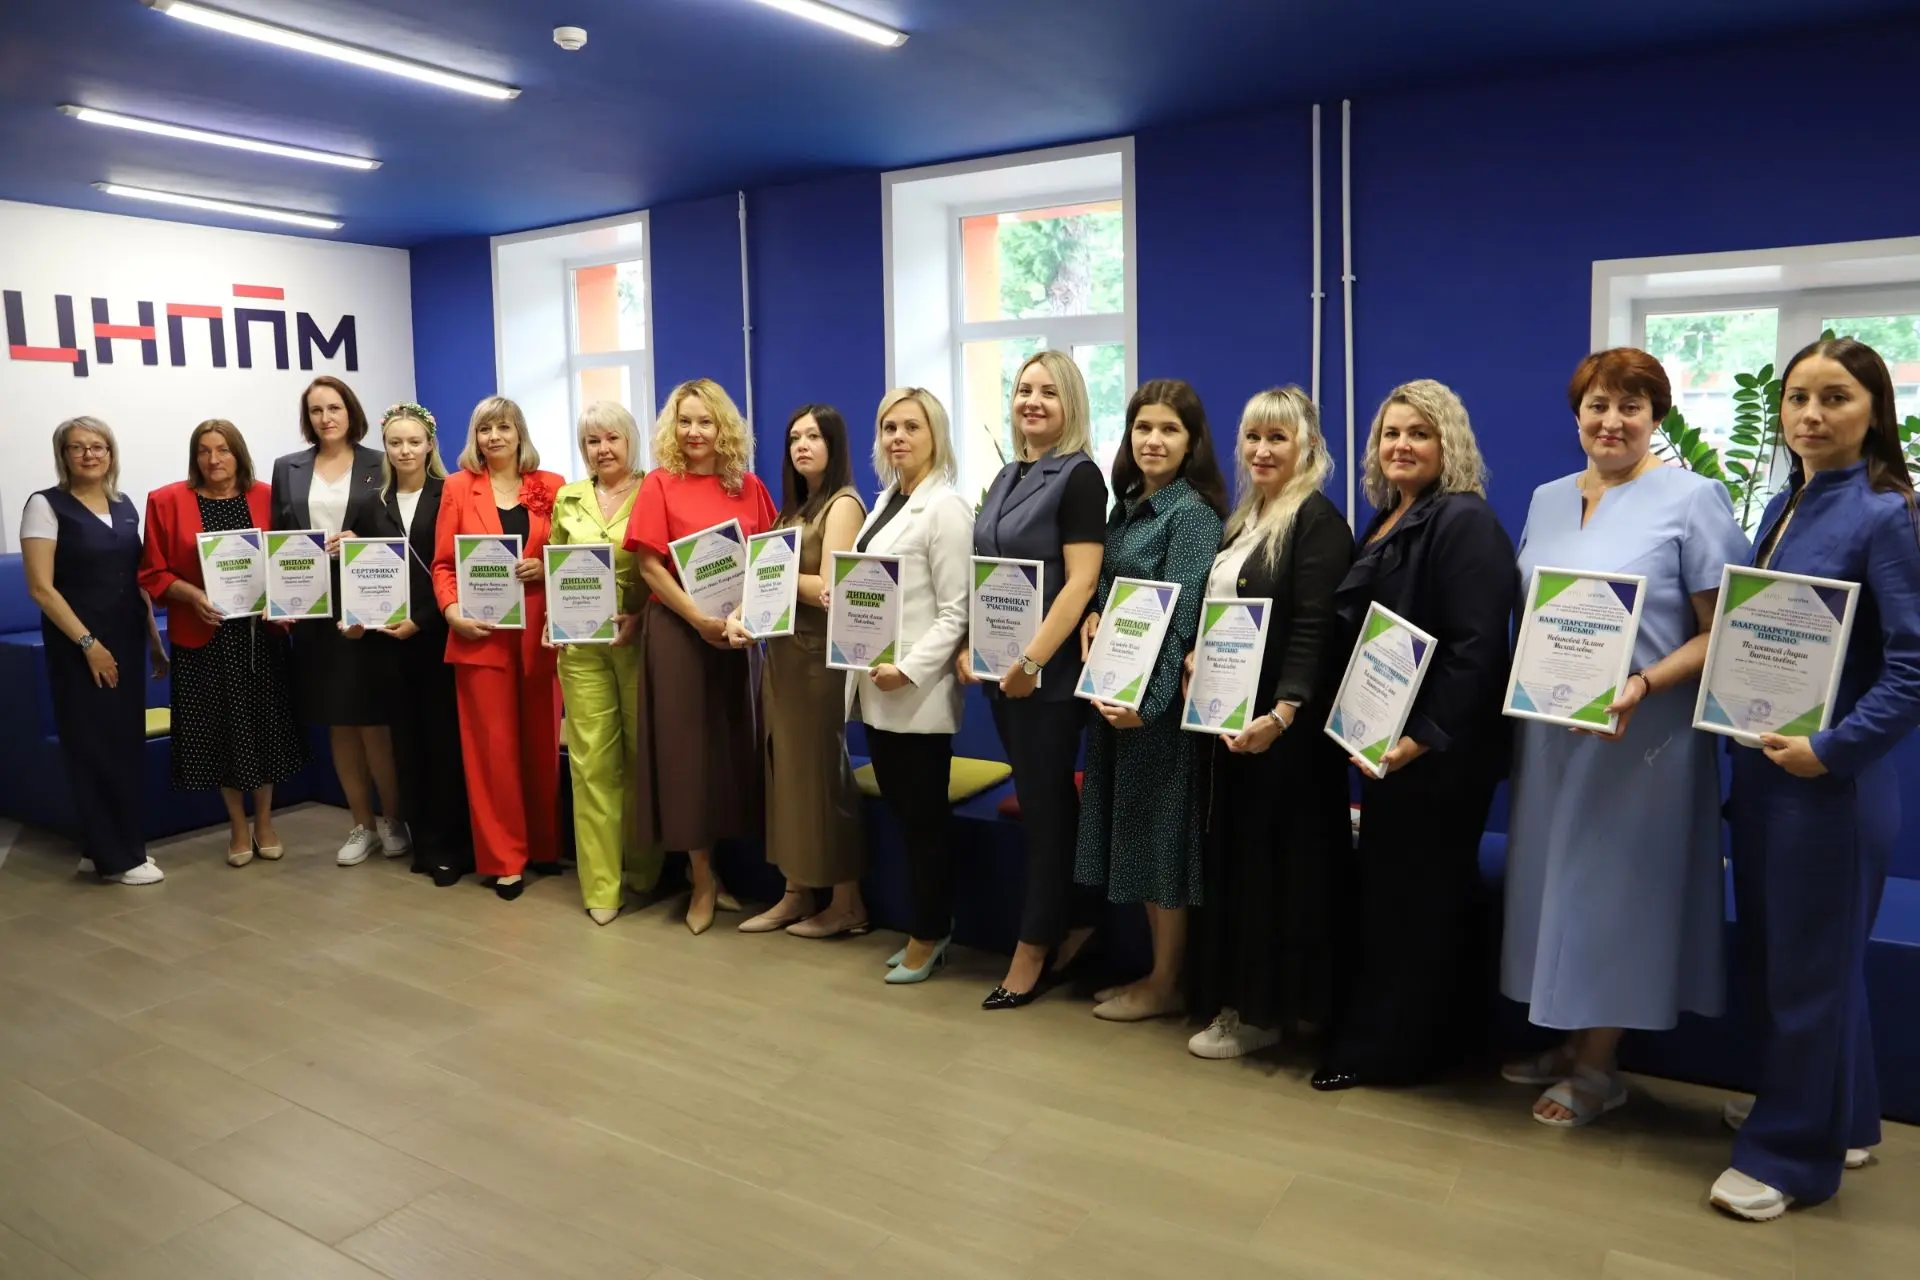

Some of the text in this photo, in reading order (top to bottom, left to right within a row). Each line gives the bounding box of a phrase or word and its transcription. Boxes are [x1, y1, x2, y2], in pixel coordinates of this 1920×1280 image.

[3, 284, 358, 377] ЦНППМ
[696, 555, 733, 575] ДИПЛОМ
[561, 577, 600, 585] ДИПЛОМ
[846, 590, 885, 601] ДИПЛОМ
[980, 595, 1030, 607] СЕРТИФИКАТ
[986, 603, 1024, 612] УЧАСТНИКА
[1114, 618, 1151, 631] ДИПЛОМ
[1538, 616, 1621, 632] БЛАГОДАРСТВЕННОЕ
[1560, 625, 1595, 635] ПИСЬМО
[1731, 619, 1828, 643] БЛАГОДАРСТВЕННОЕ
[1757, 631, 1797, 645] ПИСЬМО
